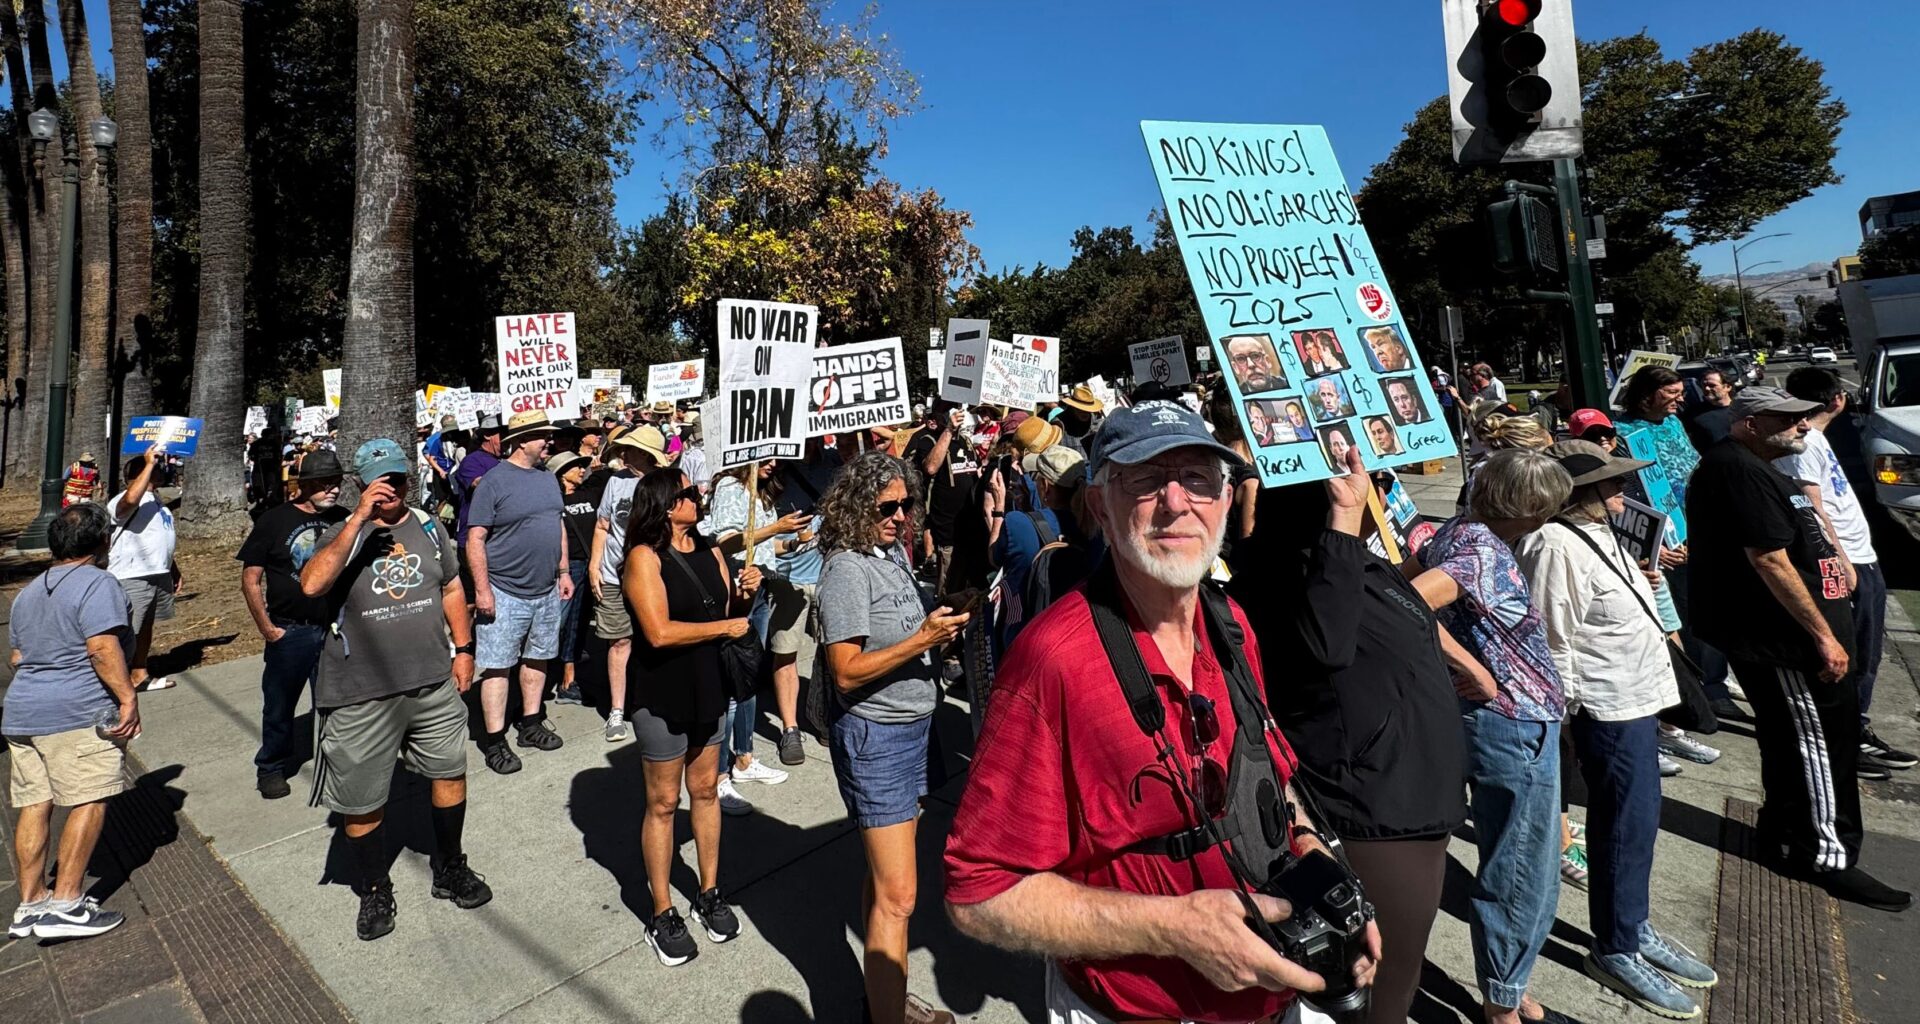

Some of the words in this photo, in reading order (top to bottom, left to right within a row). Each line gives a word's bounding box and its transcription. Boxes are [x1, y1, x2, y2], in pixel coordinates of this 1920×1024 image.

[1159, 135, 1207, 176] NO
[1177, 194, 1225, 231] NO
[1198, 246, 1243, 289] NO
[505, 314, 568, 338] HATE
[730, 306, 757, 341] NO
[761, 308, 809, 343] WAR
[519, 337, 553, 347] WILL
[1133, 345, 1150, 354] STOP
[1150, 340, 1177, 351] TEARING
[505, 343, 569, 367] NEVER
[754, 345, 772, 376] ON
[813, 351, 893, 379] HANDS
[952, 353, 976, 368] FELON
[992, 344, 1020, 361] Hands
[1021, 352, 1041, 366] OFF!
[1132, 350, 1161, 362] FAMILIES
[1162, 346, 1181, 356] APART
[1650, 357, 1673, 367] WITH
[508, 366, 544, 380] MAKE
[547, 361, 573, 374] OUR
[1152, 361, 1169, 377] ICE
[507, 376, 573, 396] COUNTRY
[812, 370, 897, 408] OFF!
[510, 390, 567, 413] GREAT
[729, 388, 796, 445] IRAN
[808, 403, 905, 433] IMMIGRANTS
[725, 450, 737, 465] SAN
[737, 448, 750, 462] JOSE
[777, 444, 797, 456] WAR
[285, 523, 307, 546] IMAGINE
[361, 607, 390, 617] MARCH
[391, 604, 405, 612] FOR
[406, 598, 433, 609] SCIENCE
[375, 607, 424, 621] SACRAMENTO
